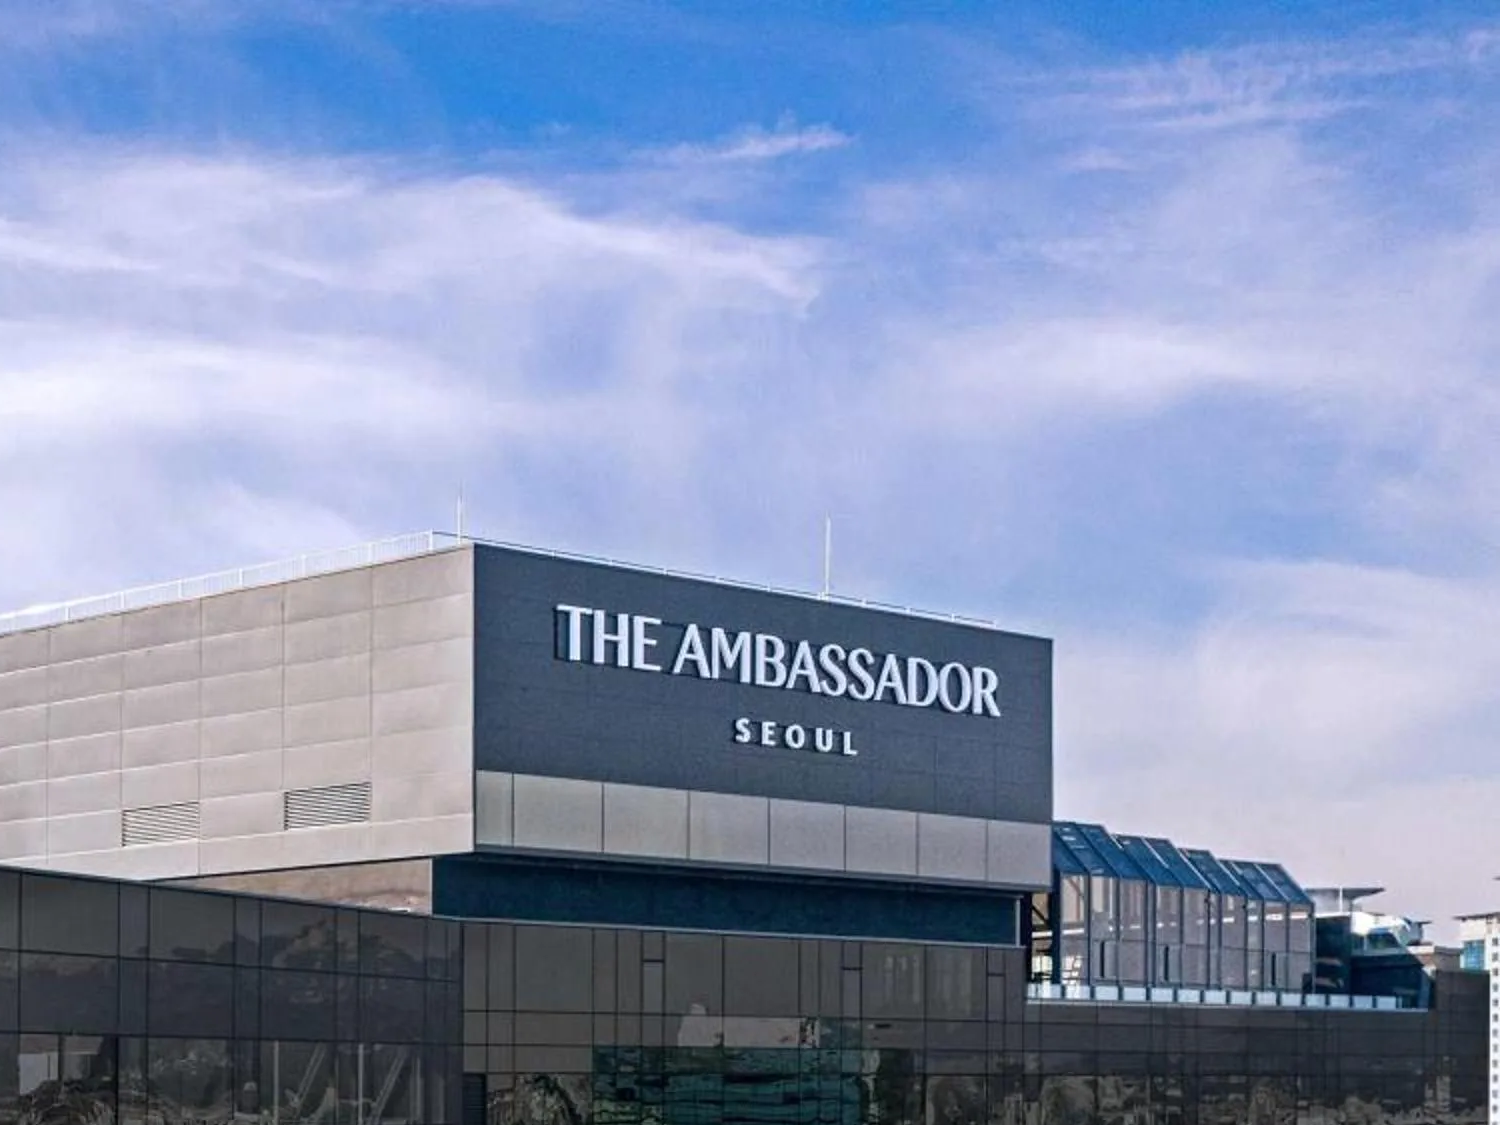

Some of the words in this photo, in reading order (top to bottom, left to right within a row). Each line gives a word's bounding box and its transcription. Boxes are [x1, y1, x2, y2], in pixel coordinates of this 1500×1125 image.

[557, 604, 662, 672] THE
[673, 623, 1002, 717] AMBASSADOR
[735, 717, 858, 756] SEOUL
